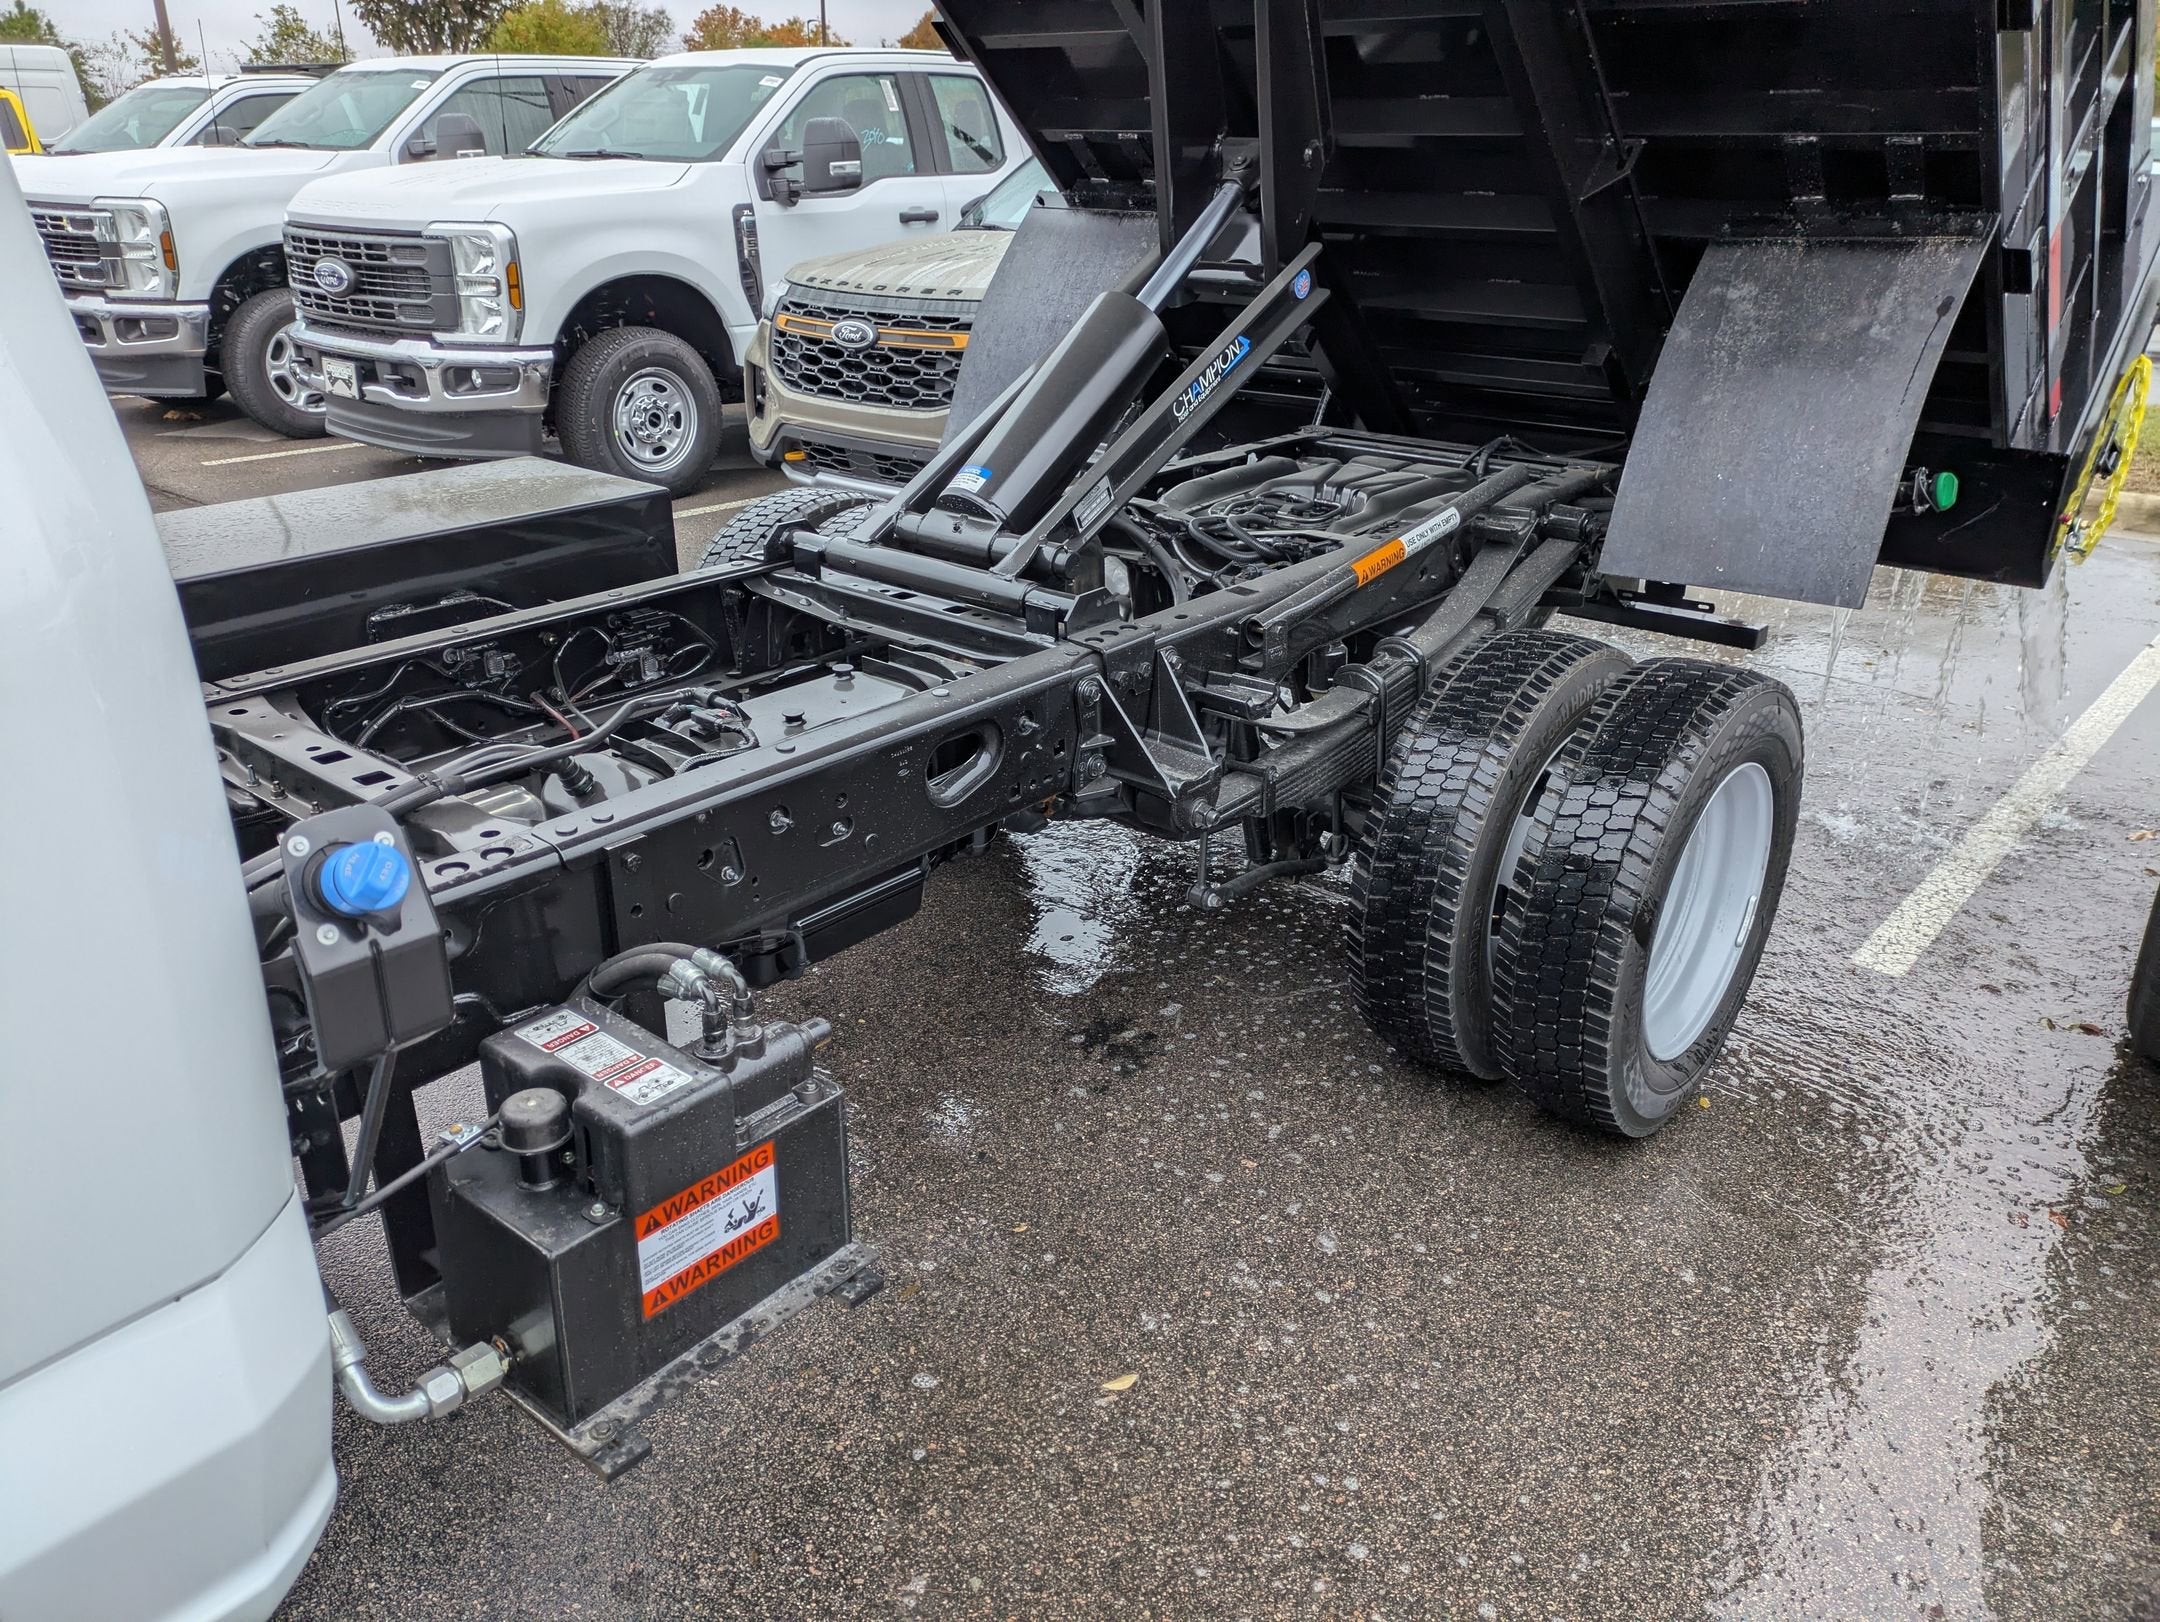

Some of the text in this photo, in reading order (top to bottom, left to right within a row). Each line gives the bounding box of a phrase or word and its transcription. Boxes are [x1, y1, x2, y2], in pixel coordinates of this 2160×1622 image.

[805, 276, 963, 296] EXPLORER
[838, 325, 863, 342] Ford
[1173, 339, 1240, 417] CHAMPION
[1189, 400, 1199, 412] and
[1197, 375, 1221, 403] Equipment
[1368, 547, 1406, 577] WARNING
[1405, 536, 1416, 548] USE
[1416, 529, 1430, 543] ONLY
[1429, 522, 1442, 535] WITH
[1441, 512, 1458, 528] EMPTY
[546, 1029, 581, 1049] DANGER
[595, 1059, 630, 1078] DANGER
[623, 1062, 658, 1081] DANGER
[662, 1149, 769, 1222] WARNING
[660, 1214, 687, 1234] ROTATING
[669, 1221, 773, 1296] WARNING
